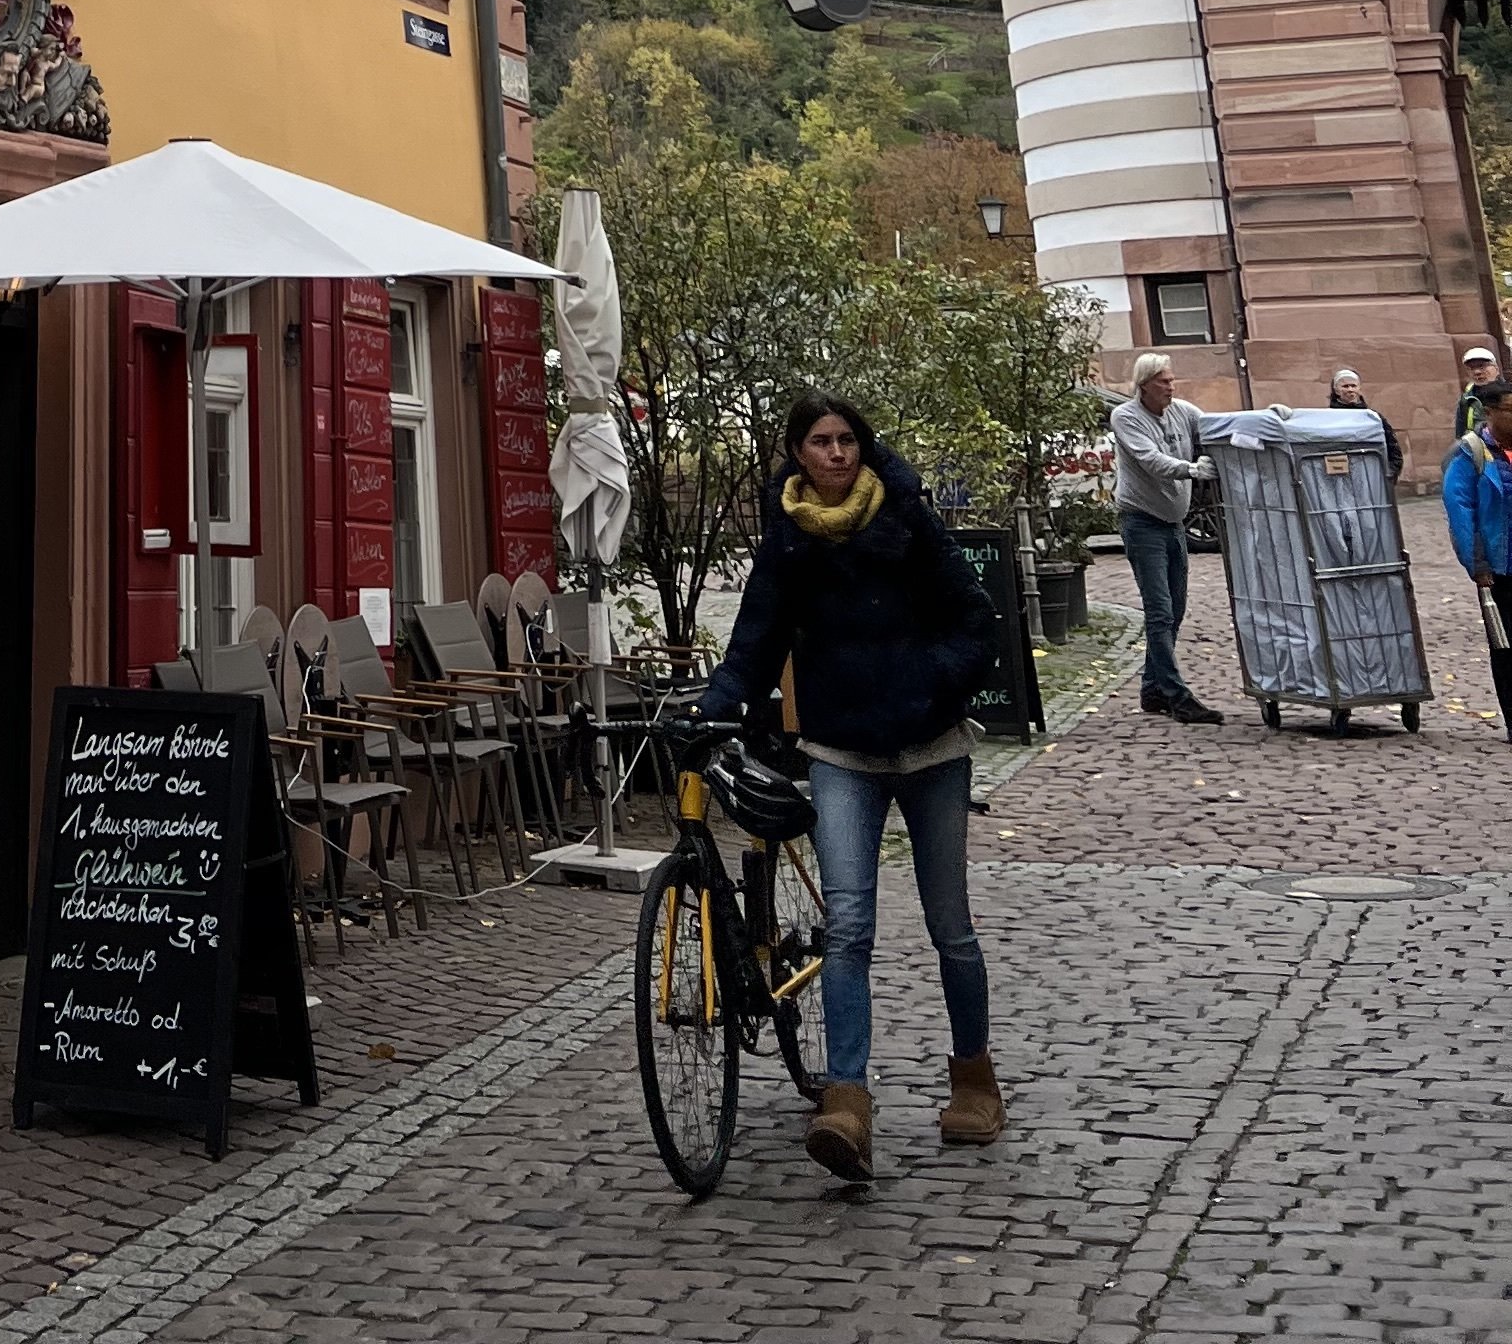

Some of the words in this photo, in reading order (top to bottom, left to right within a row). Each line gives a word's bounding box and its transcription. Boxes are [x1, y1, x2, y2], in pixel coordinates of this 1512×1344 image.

[71, 716, 164, 781] Langsam
[64, 772, 106, 797] man
[114, 761, 160, 792] über
[165, 769, 206, 797] den
[60, 803, 86, 839] 1.
[90, 802, 223, 850] hausgemachten
[72, 846, 189, 903] Glühwein
[51, 941, 85, 969] mit
[92, 945, 157, 983] Schuß
